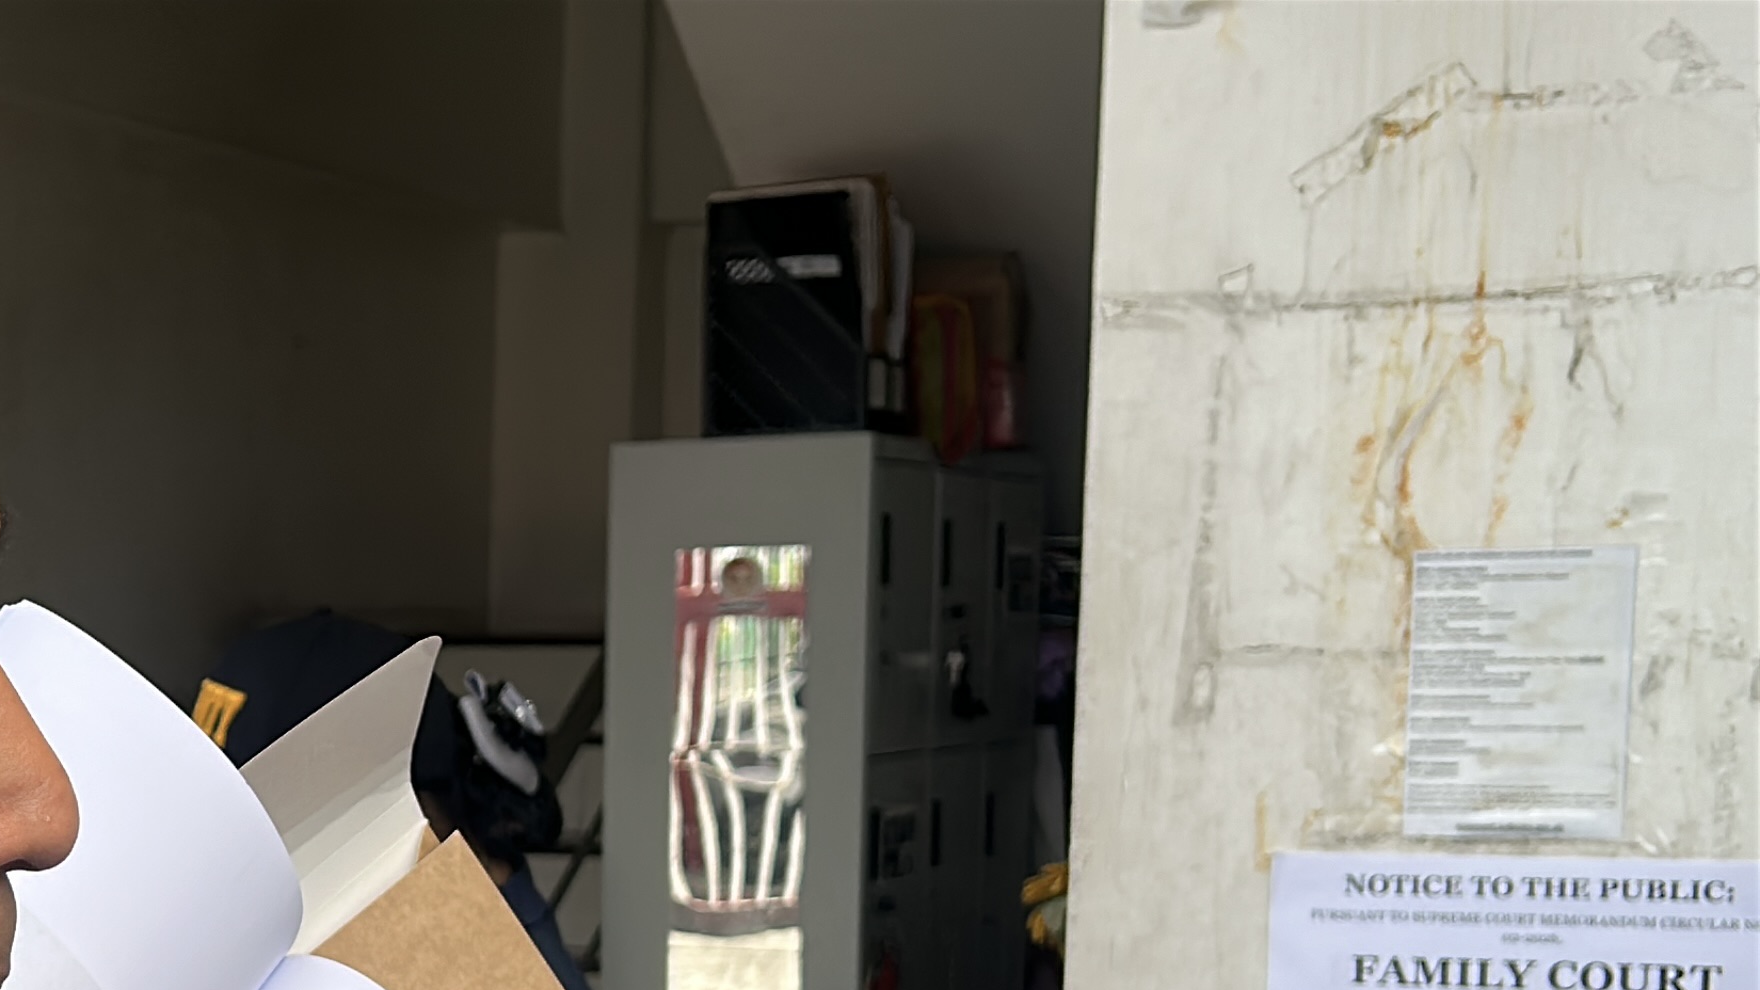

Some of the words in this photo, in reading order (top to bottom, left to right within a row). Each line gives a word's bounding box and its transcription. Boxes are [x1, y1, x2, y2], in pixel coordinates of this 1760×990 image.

[1344, 873, 1463, 898] NOTICE
[1471, 875, 1514, 899] TO
[1521, 876, 1590, 900] THE
